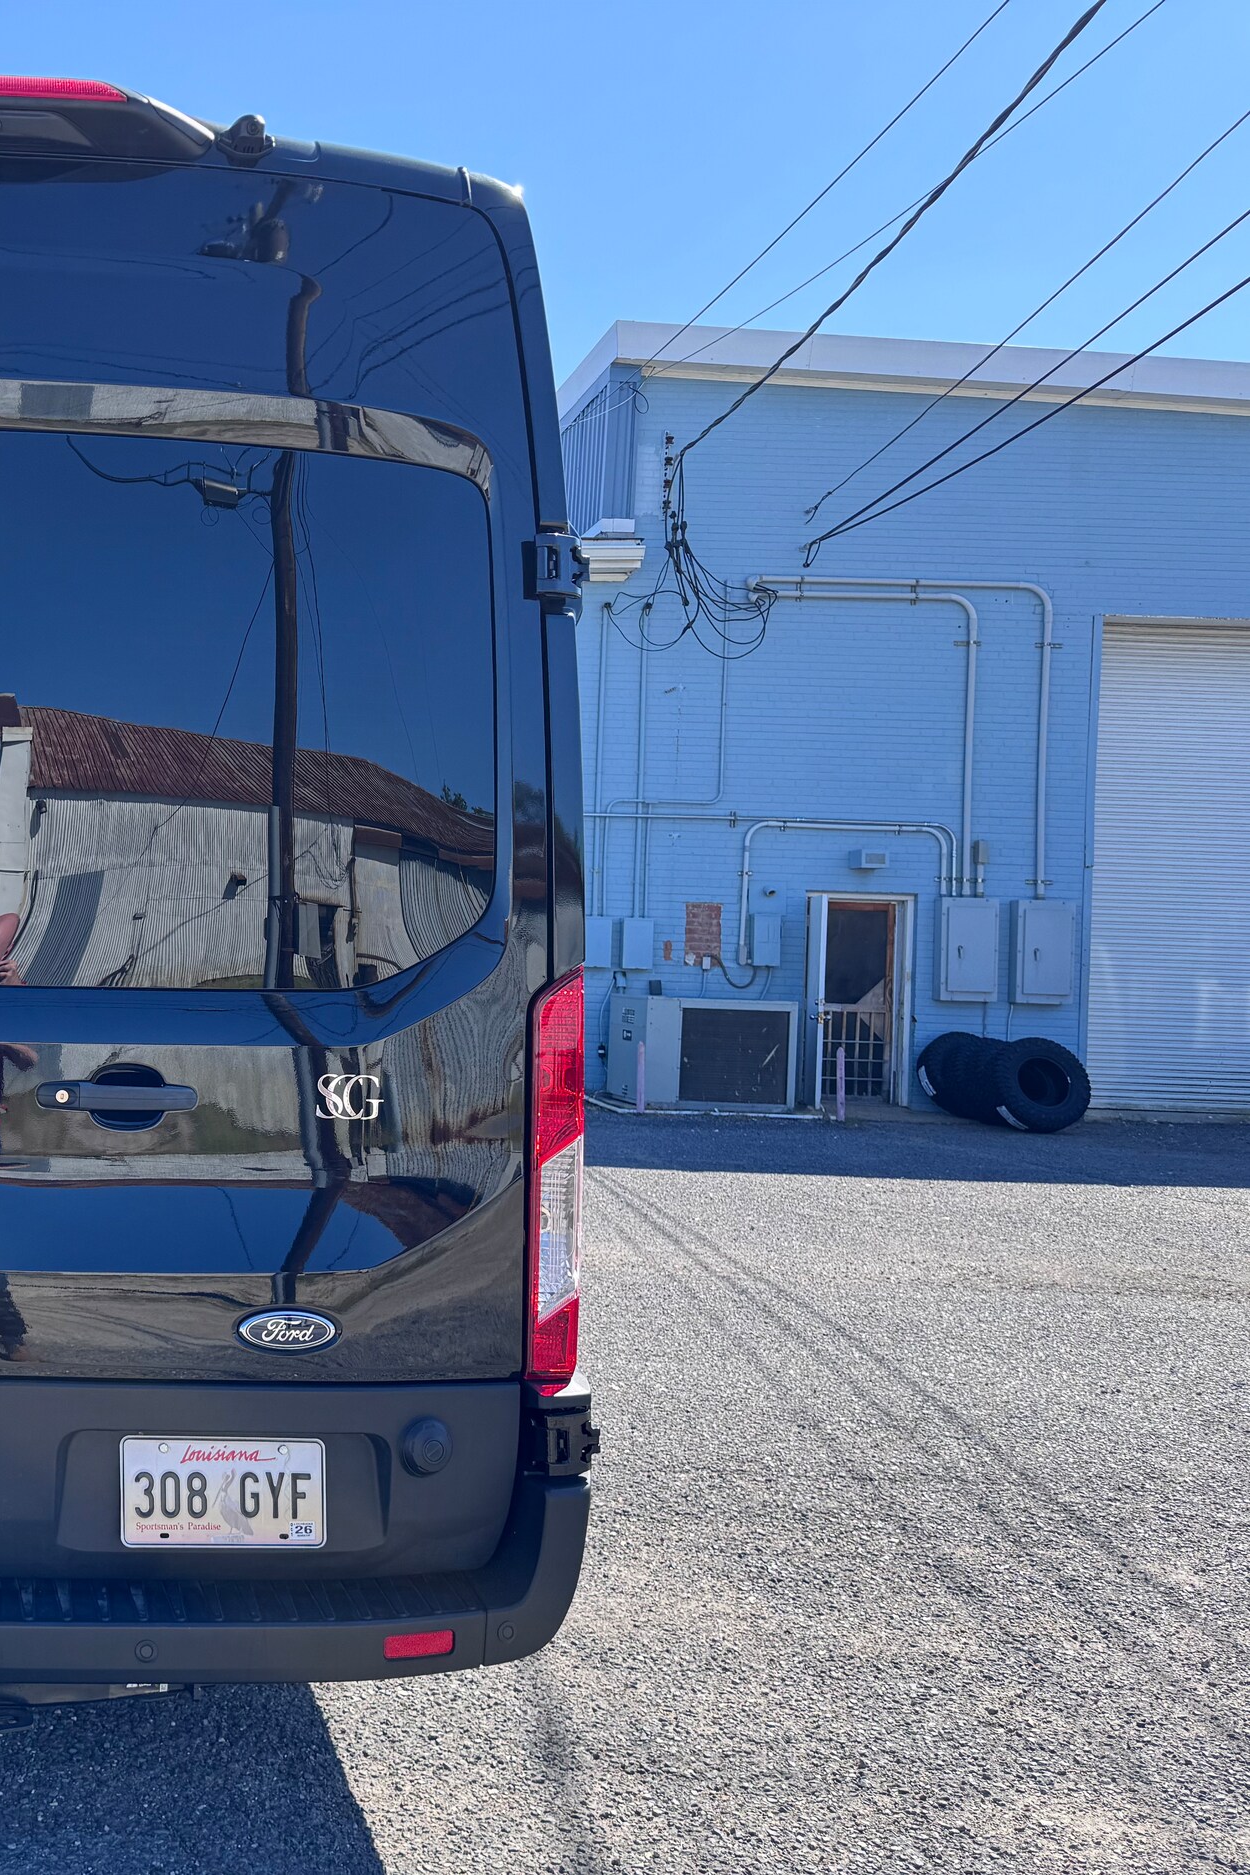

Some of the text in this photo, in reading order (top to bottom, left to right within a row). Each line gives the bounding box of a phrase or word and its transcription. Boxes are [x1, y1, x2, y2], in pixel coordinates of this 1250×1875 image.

[261, 1318, 315, 1342] Ford
[179, 1444, 276, 1465] Louisiana
[134, 1471, 312, 1520] 308 GYF
[136, 1521, 222, 1532] Sportsman's Paradise
[294, 1525, 313, 1535] 26
